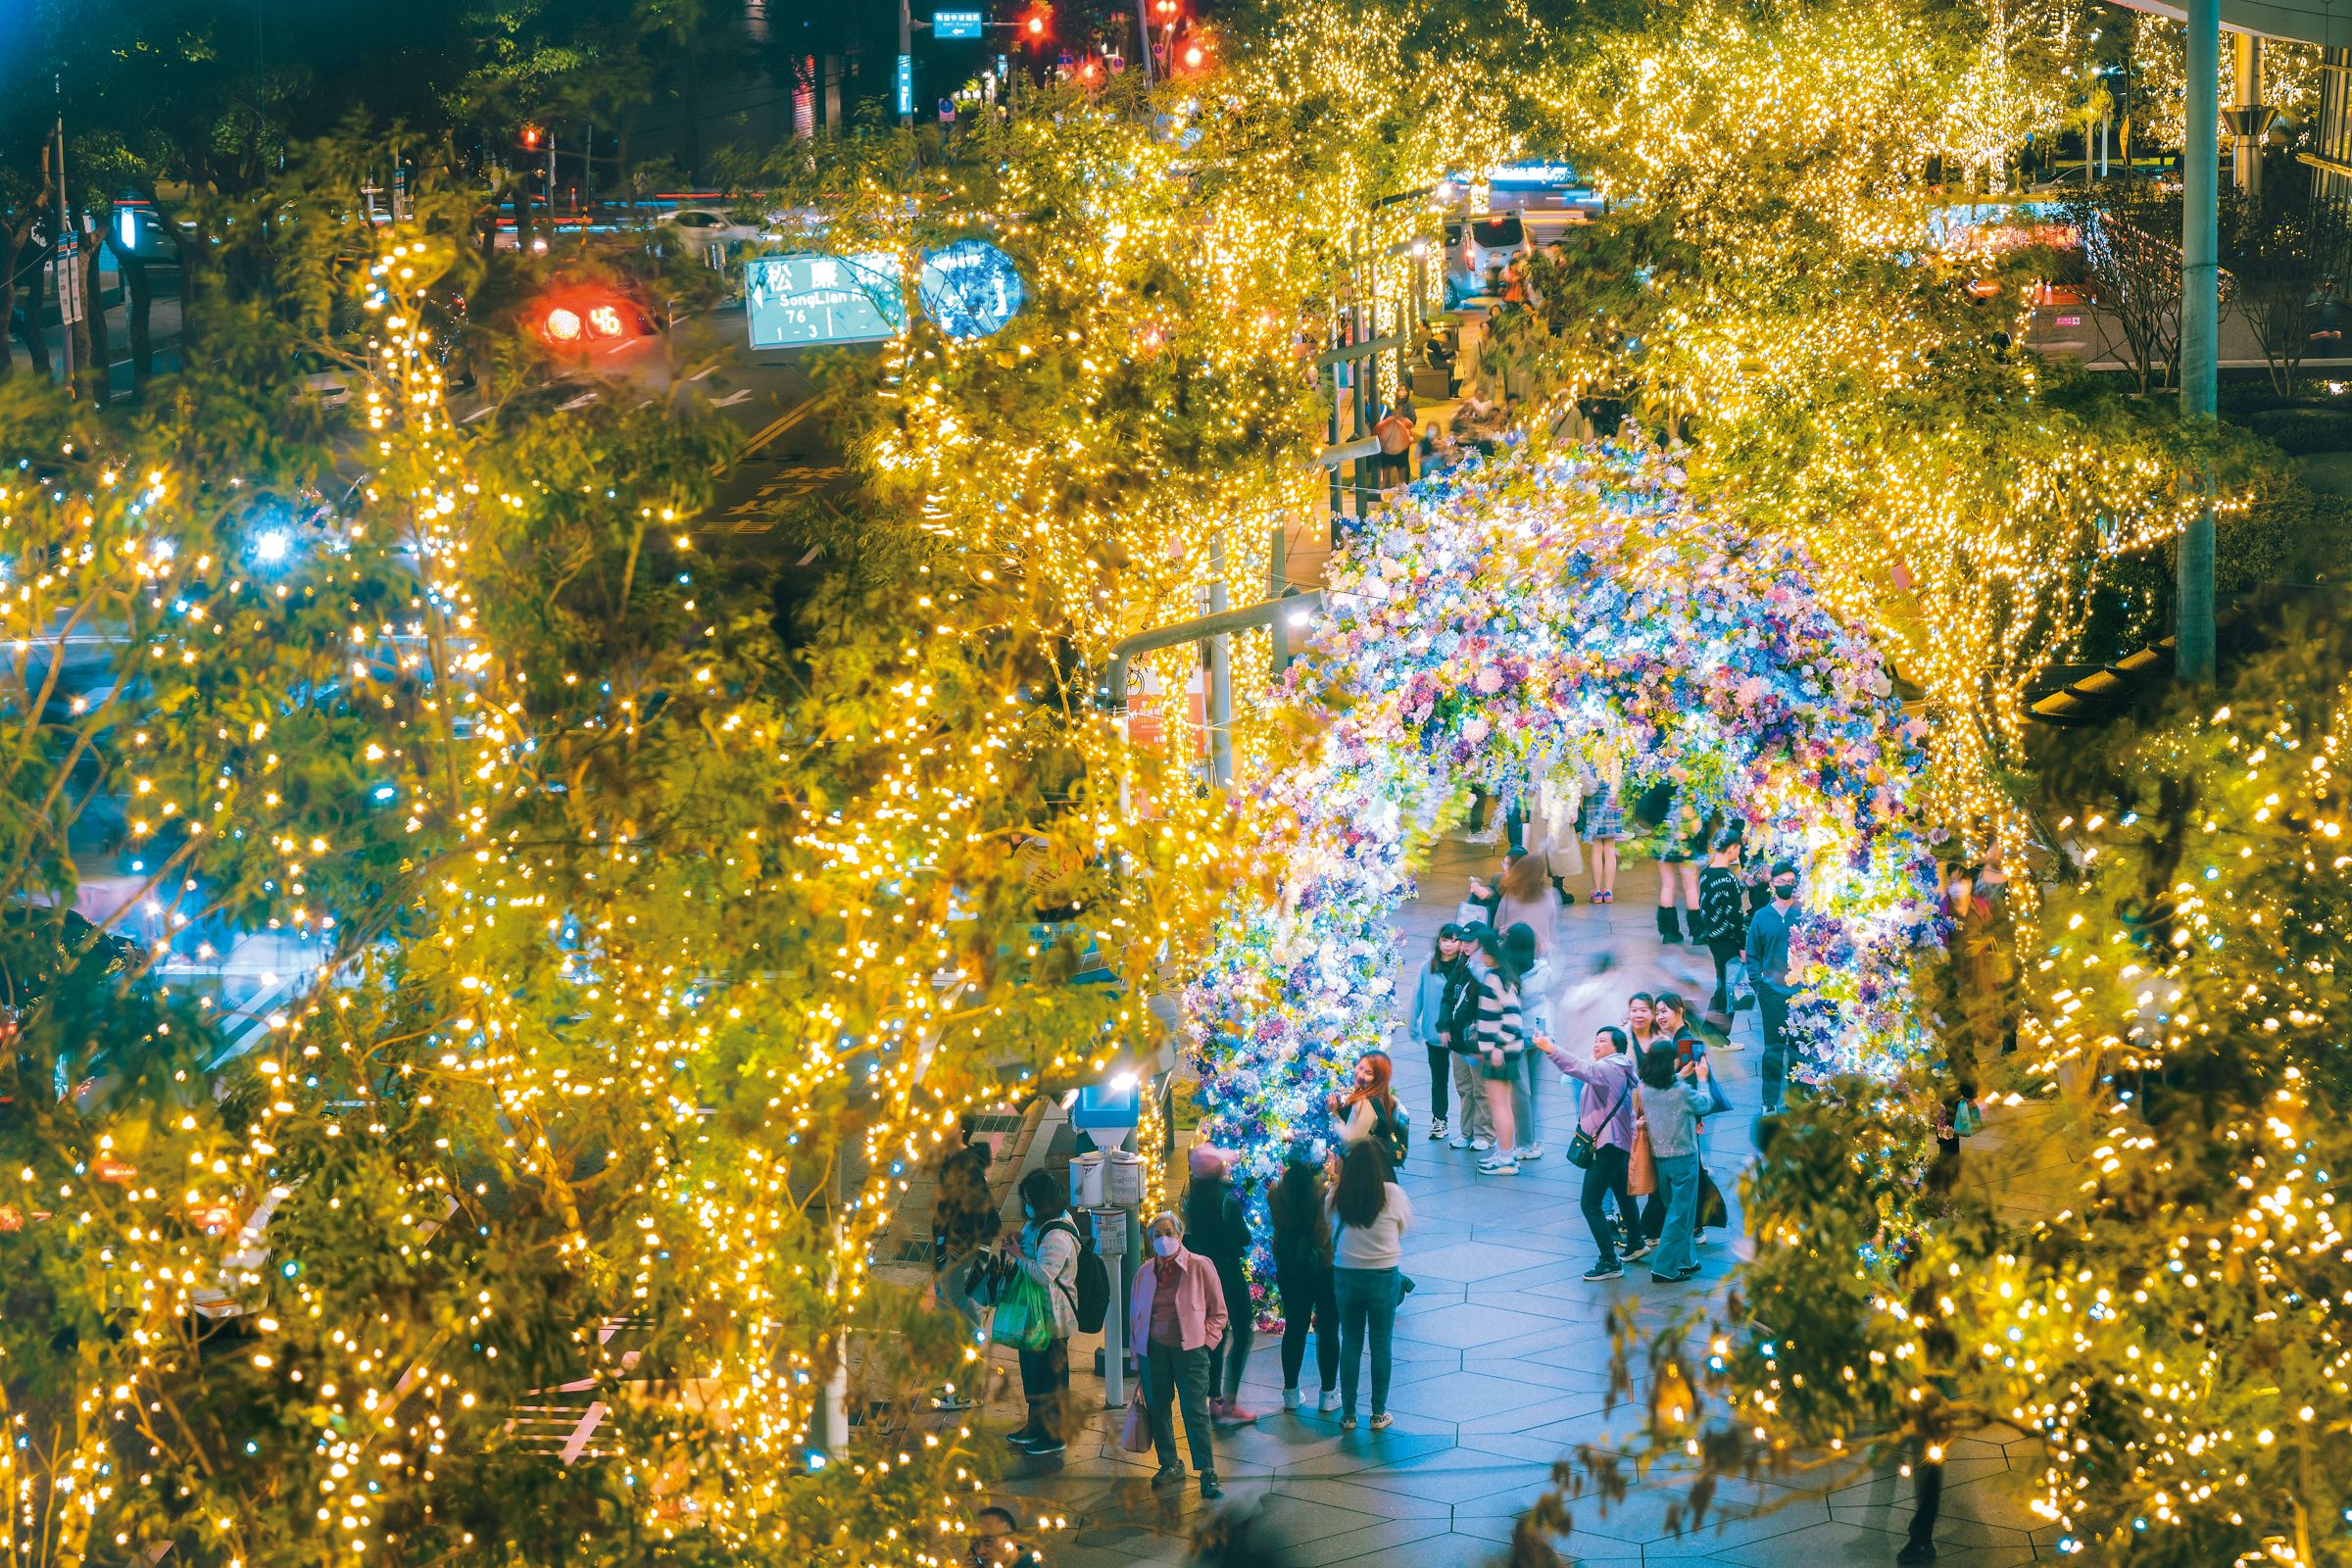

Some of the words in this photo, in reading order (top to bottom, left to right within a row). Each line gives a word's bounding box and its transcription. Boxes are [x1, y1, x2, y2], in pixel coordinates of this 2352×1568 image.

[779, 291, 848, 309] SongLian
[590, 306, 621, 335] 46
[785, 309, 807, 324] 76
